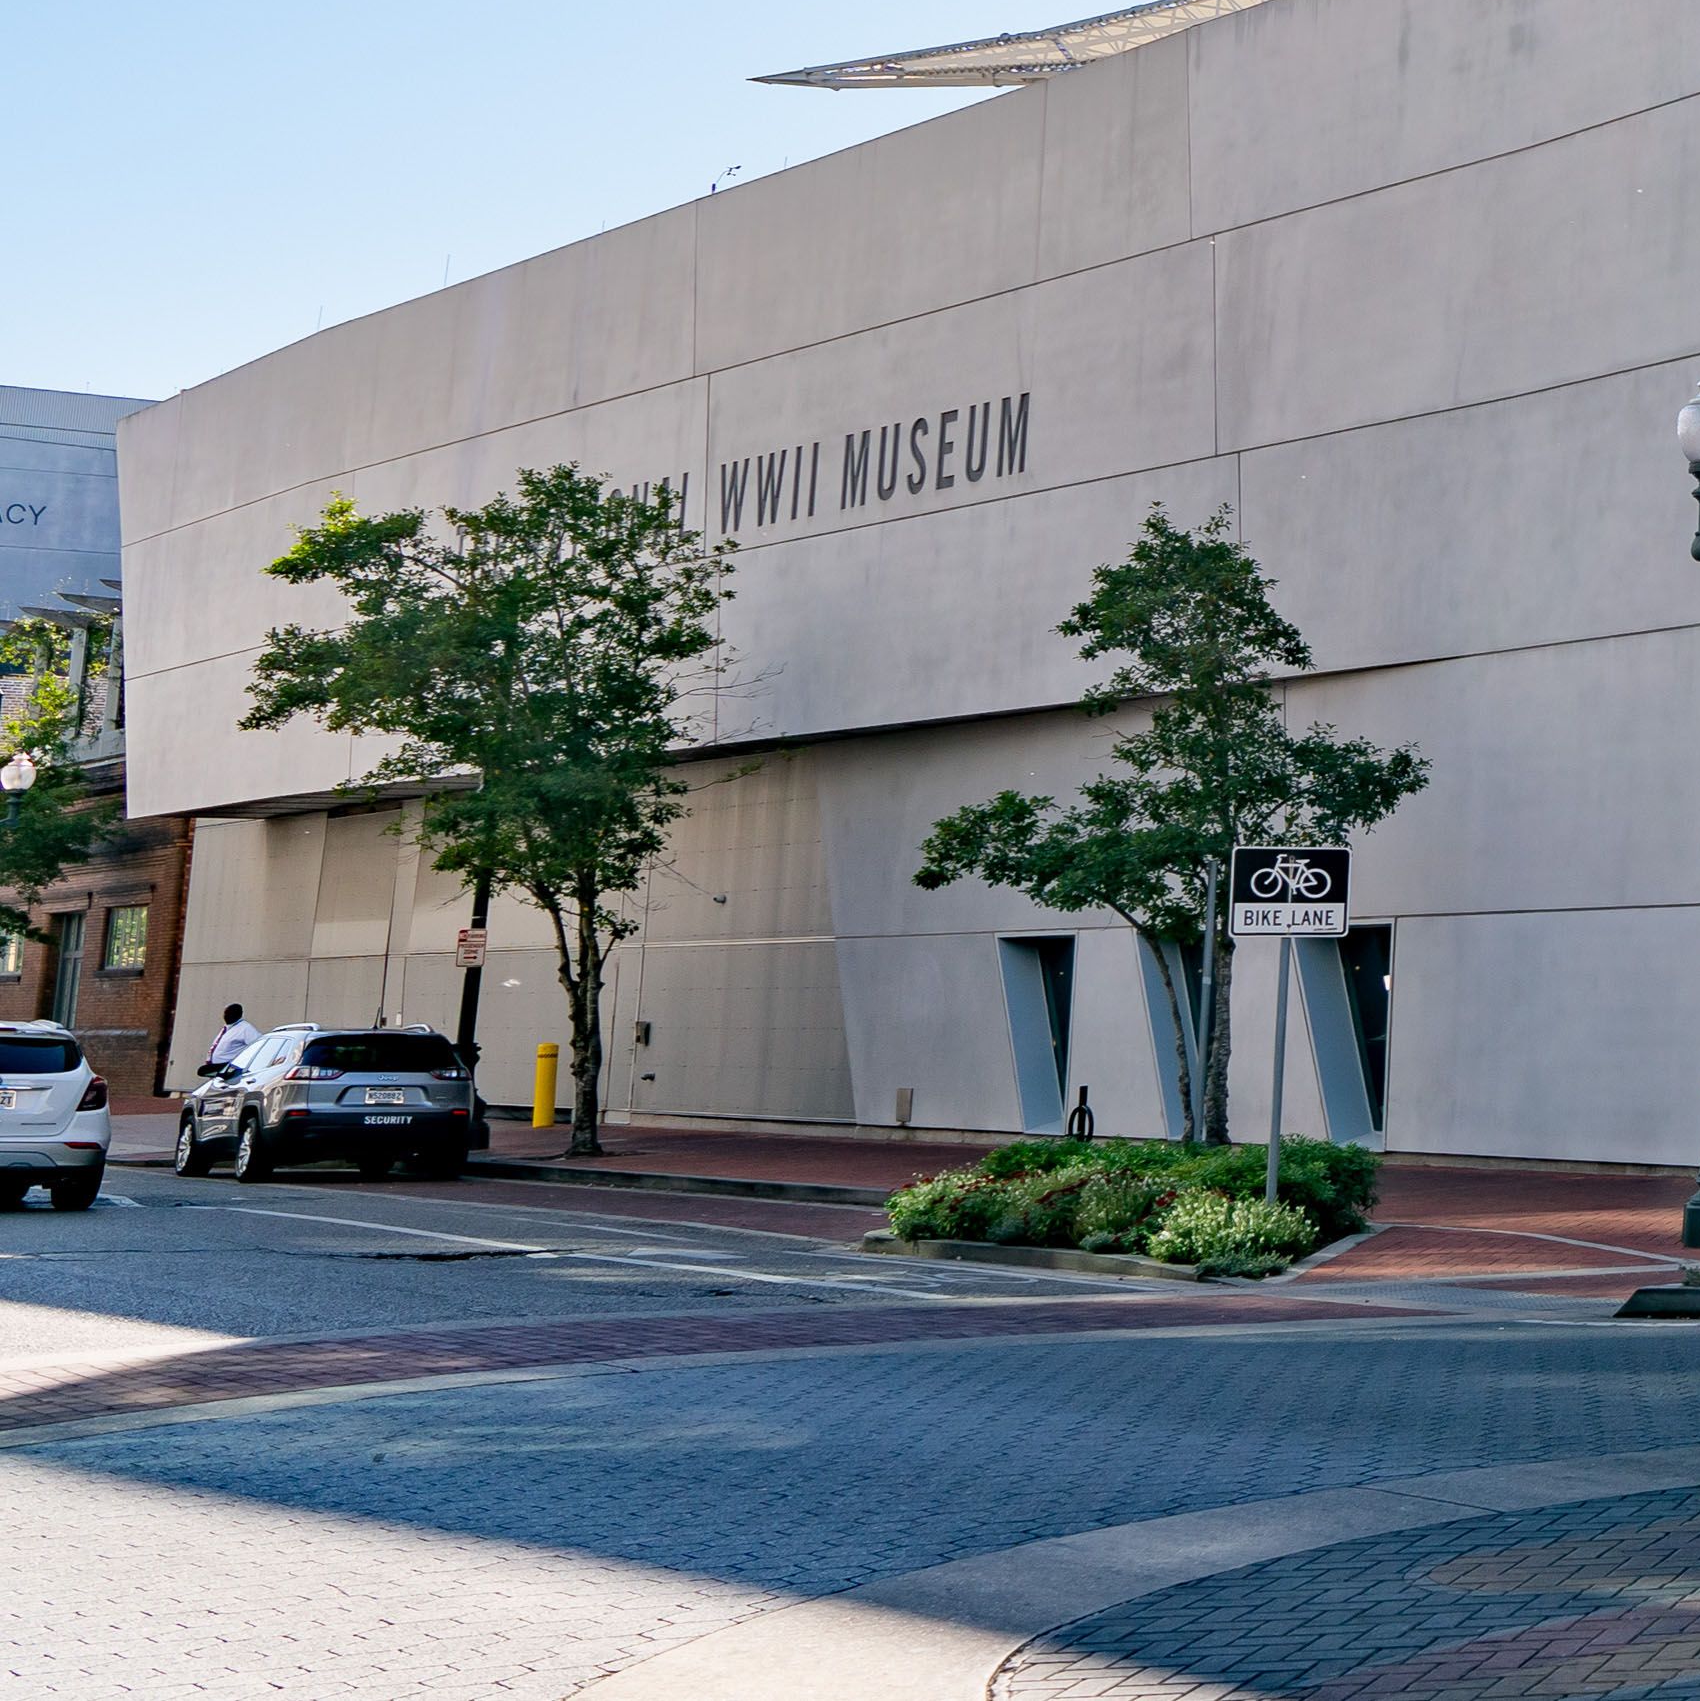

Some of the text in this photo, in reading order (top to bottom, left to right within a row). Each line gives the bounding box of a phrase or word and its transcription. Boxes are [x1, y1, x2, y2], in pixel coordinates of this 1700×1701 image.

[720, 441, 820, 535] WWII
[839, 391, 1031, 510] MUSEUM
[0, 503, 47, 526] CY
[1243, 909, 1335, 927] BIKE LANE
[363, 1115, 413, 1125] SECURITY
